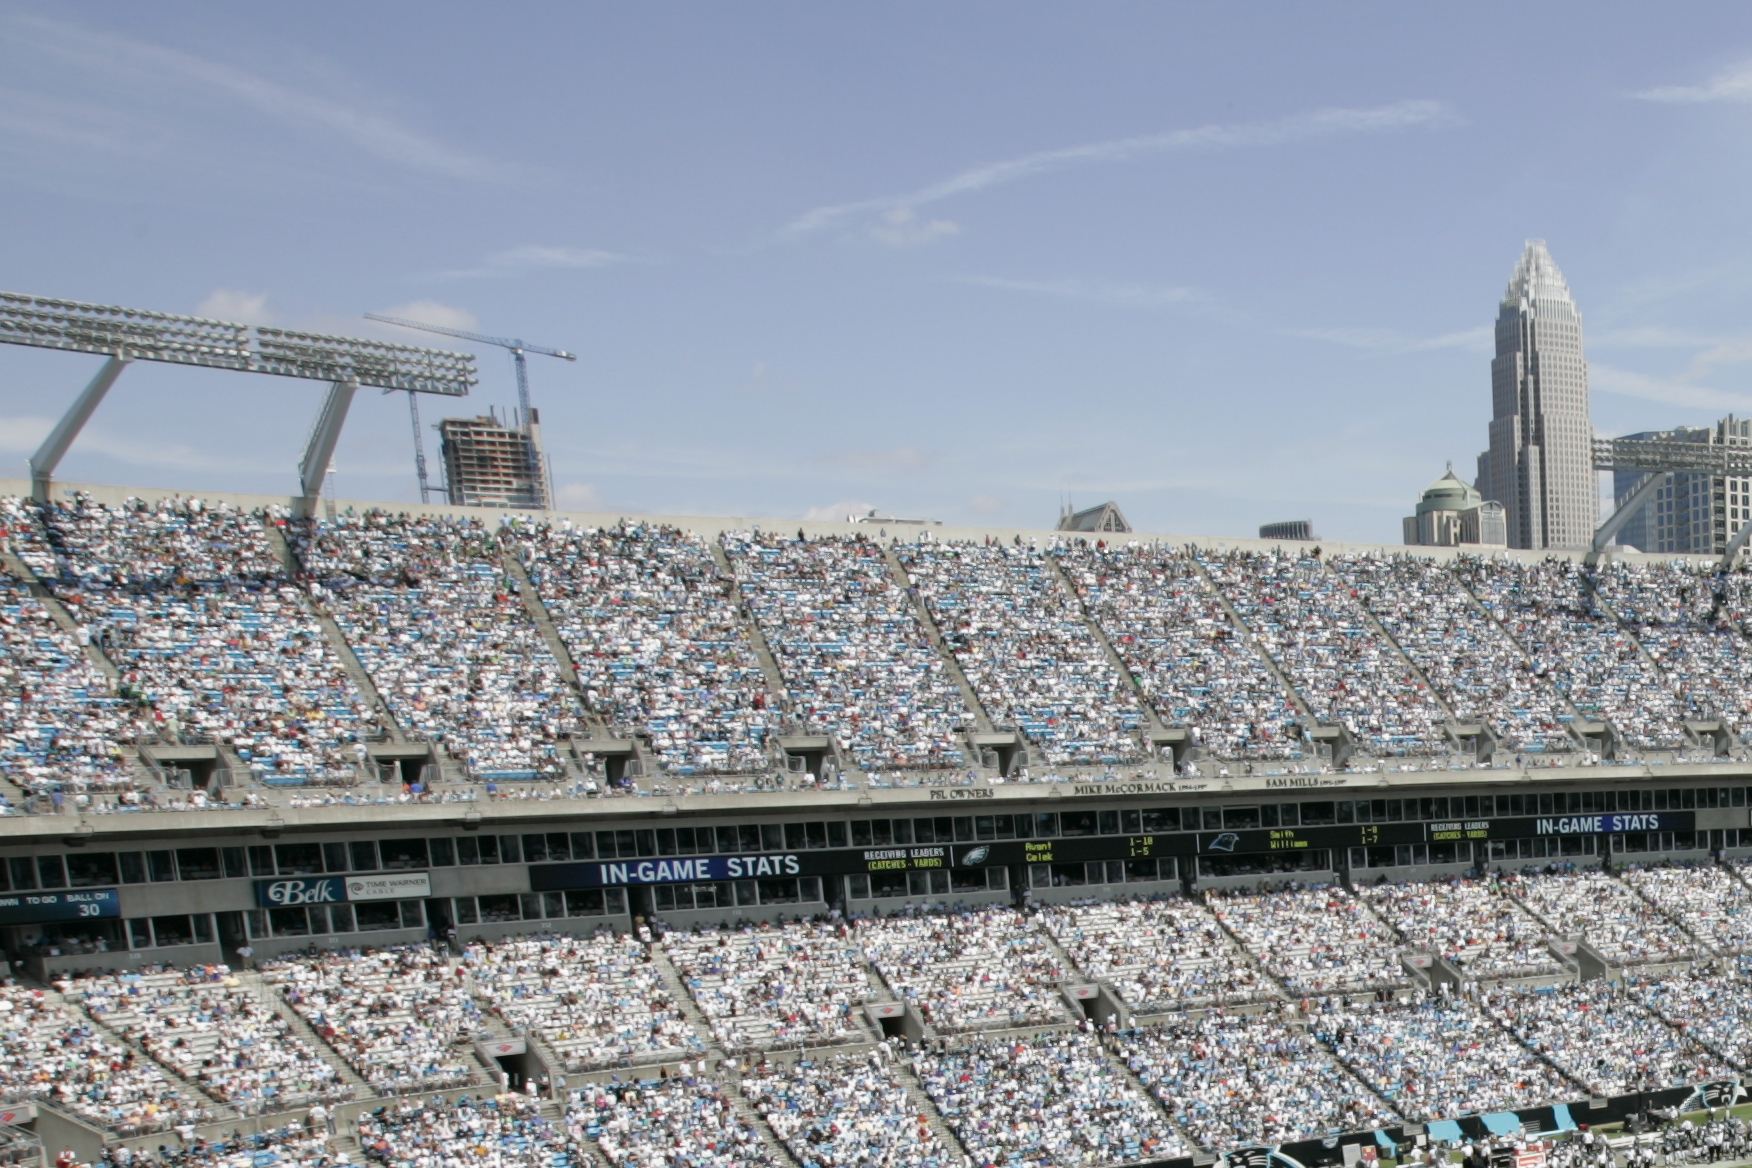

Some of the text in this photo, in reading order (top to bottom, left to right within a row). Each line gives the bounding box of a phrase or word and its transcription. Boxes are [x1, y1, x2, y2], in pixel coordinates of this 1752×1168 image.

[1074, 784, 1101, 795] MIKE
[1105, 782, 1176, 794] McCORMACK
[1266, 778, 1288, 788] SAM
[1289, 777, 1319, 787] MILLS
[930, 788, 994, 800] PSL OWNERS
[1464, 821, 1490, 829] LEADERS
[1536, 814, 1659, 835] IN-GAME STATS
[1270, 830, 1295, 839] Smith
[1025, 841, 1052, 851] Avant
[1270, 839, 1308, 849] Williams
[864, 847, 944, 860] RECEIVING LEADERS
[1026, 846, 1149, 862] Celek 1-5
[913, 858, 942, 868] YARDS)
[600, 854, 800, 885] IN-GAME STATS
[389, 878, 427, 887] WARNER
[26, 895, 40, 904] TO
[41, 895, 57, 904] GO
[66, 893, 93, 902] BALL
[95, 892, 109, 900] ON
[268, 879, 337, 905] Belk
[79, 903, 100, 916] 30
